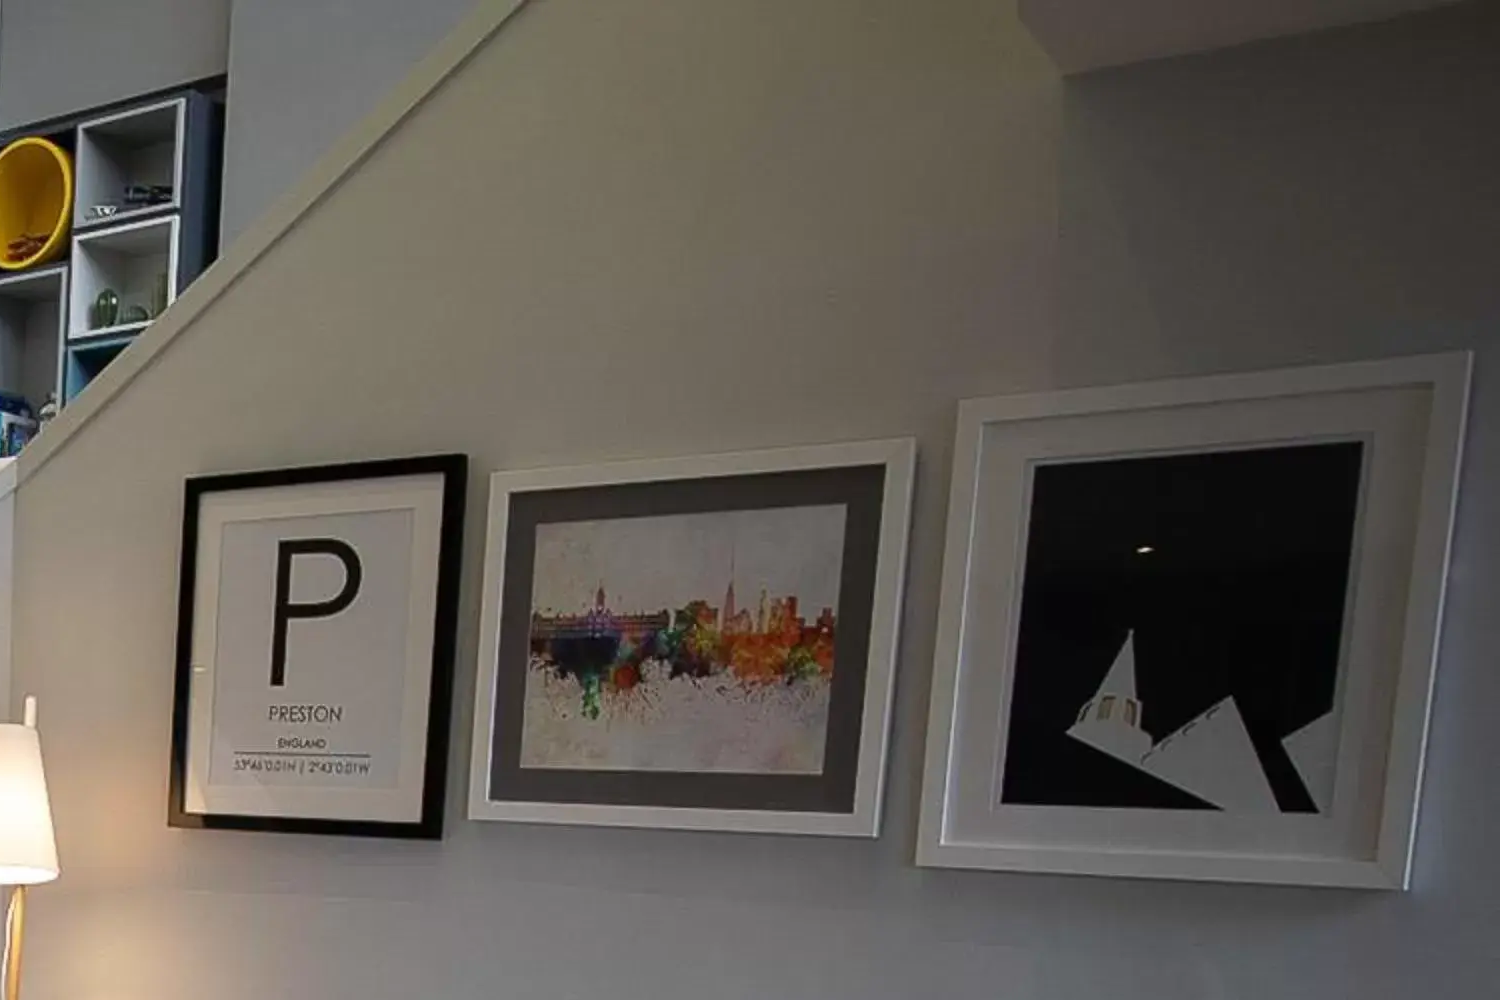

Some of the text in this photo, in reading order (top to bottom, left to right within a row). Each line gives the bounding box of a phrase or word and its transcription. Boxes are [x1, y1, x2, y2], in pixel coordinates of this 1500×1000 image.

[270, 537, 361, 687] P
[268, 704, 342, 723] PRESTON
[277, 737, 327, 749] ENGLAND
